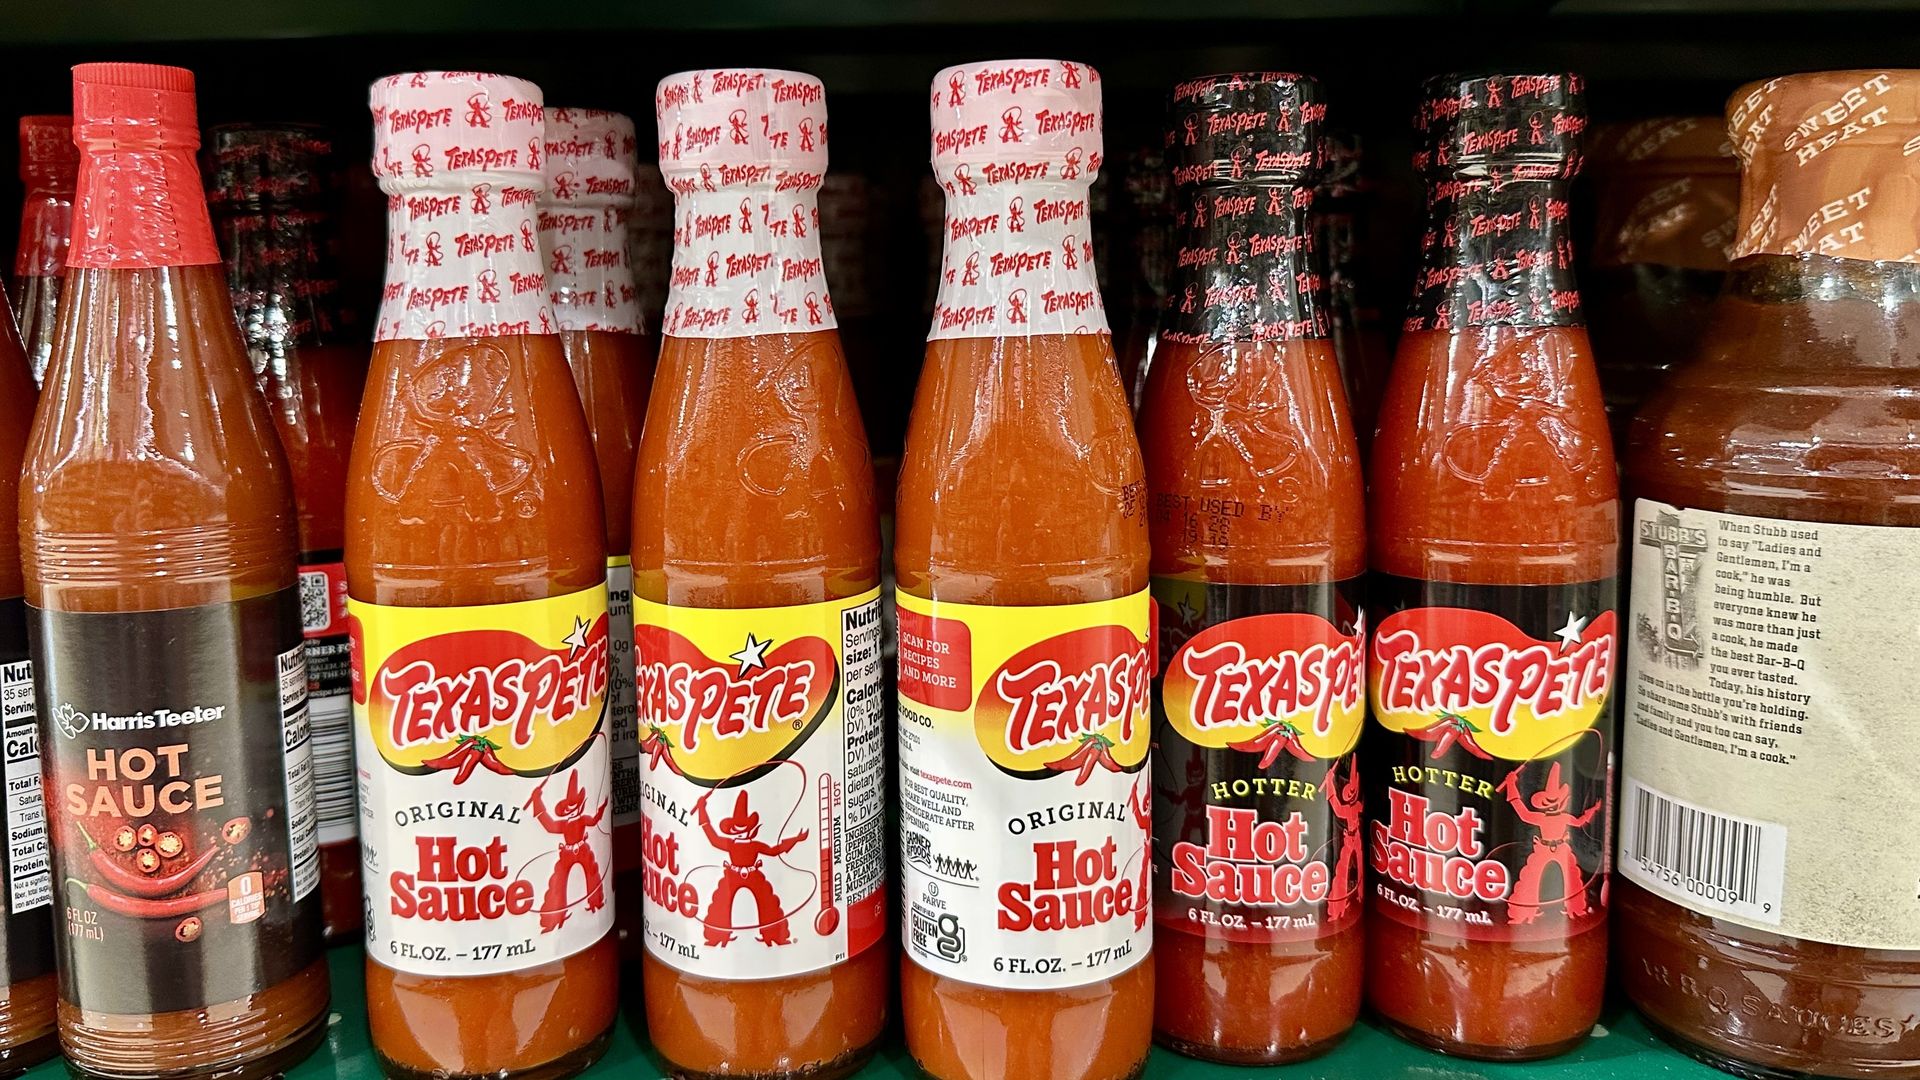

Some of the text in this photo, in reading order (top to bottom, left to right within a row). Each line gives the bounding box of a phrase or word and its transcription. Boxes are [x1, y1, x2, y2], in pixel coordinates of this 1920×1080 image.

[1783, 74, 1891, 152] SWEET
[1795, 105, 1889, 167] HEAT
[1201, 498, 1244, 517] USED
[1719, 520, 1819, 541] When Stubb used
[1718, 536, 1728, 547] to
[1730, 538, 1750, 551] say
[1799, 546, 1822, 558] and
[1804, 564, 1811, 573] a
[1750, 573, 1765, 585] he
[1767, 576, 1791, 587] was
[1714, 584, 1745, 599] being
[1799, 594, 1822, 607] But
[1713, 600, 1817, 623] everyone knew he
[1712, 616, 1821, 640] was more than just
[902, 631, 950, 655] SCAN FOR
[1711, 632, 1718, 641] a
[1749, 637, 1764, 648] he
[1766, 640, 1798, 653] made
[846, 648, 872, 665] size:
[903, 648, 940, 670] RECIPES
[1711, 646, 1728, 658] the
[1730, 650, 1754, 663] best
[846, 668, 862, 686] per
[903, 664, 957, 689] AND MORE
[1709, 662, 1729, 675] you
[1731, 668, 1756, 679] ever
[1746, 684, 1764, 697] his
[1767, 688, 1811, 705] history
[1638, 685, 1646, 695] So
[1647, 690, 1666, 704] share
[1668, 698, 1689, 711] some
[1730, 712, 1756, 727] with
[1759, 718, 1803, 735] friends
[919, 715, 934, 729] CO.
[6, 728, 33, 739] Amount
[1658, 725, 1673, 737] and
[1750, 750, 1757, 758] a
[87, 744, 188, 780] HOT
[9, 780, 31, 791] Total
[847, 772, 875, 794] dietary
[914, 782, 928, 796] BEST
[920, 768, 972, 790] texaspete.com
[1211, 778, 1316, 800] HOTTER
[1392, 766, 1494, 799] HOTTER
[66, 775, 224, 817] SAUCE
[922, 796, 940, 813] WELL
[942, 805, 962, 817] AND
[20, 811, 40, 822] Trans
[395, 801, 521, 826] ORIGINAL
[905, 799, 975, 831] REFRIGERATE AFTER
[1008, 802, 1125, 835] ORIGINAL
[1388, 786, 1482, 859] Hot
[12, 827, 43, 841] Sodium
[906, 830, 931, 850] GARNER
[1206, 805, 1308, 863] Hot
[13, 860, 44, 874] Protein
[415, 836, 508, 882] Hot
[1033, 836, 1117, 890] Hot
[1370, 820, 1509, 901] Sauce
[1172, 842, 1328, 905] Sauce
[390, 871, 534, 921] Sauce
[642, 863, 699, 918] auce
[1640, 857, 1772, 914] 34756 00009 9
[922, 894, 946, 910] PARVE
[998, 879, 1132, 931] Sauce
[1377, 883, 1383, 895] 6
[1436, 906, 1462, 921] 177
[1465, 909, 1493, 925] mL
[73, 909, 82, 924] FL
[84, 910, 97, 925] OZ
[912, 913, 938, 938] GLUTEN
[1188, 908, 1197, 921] 6
[1265, 916, 1291, 929] 177
[1293, 913, 1316, 928] mL
[390, 941, 398, 954] 6
[472, 944, 502, 961] 177
[507, 939, 536, 957] mL
[912, 930, 927, 948] FREE
[678, 943, 700, 960] mL
[994, 957, 1003, 972] 6
[1087, 949, 1110, 967] 177
[1114, 939, 1132, 960] mL
